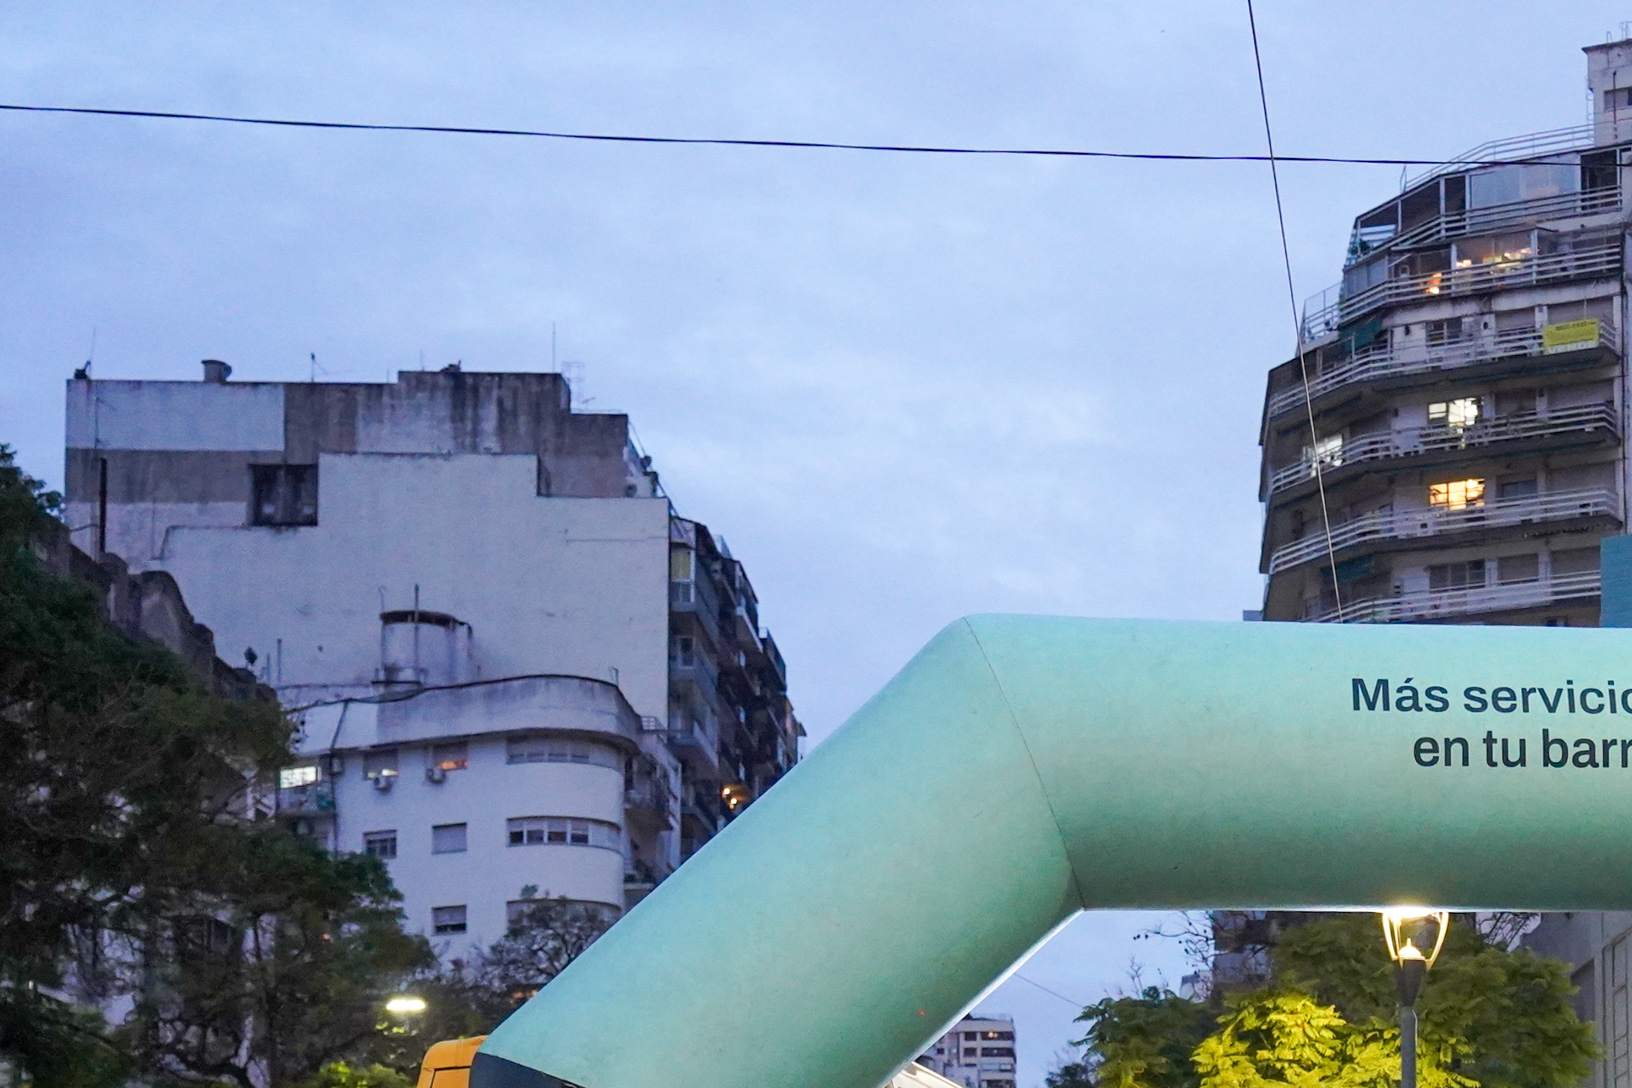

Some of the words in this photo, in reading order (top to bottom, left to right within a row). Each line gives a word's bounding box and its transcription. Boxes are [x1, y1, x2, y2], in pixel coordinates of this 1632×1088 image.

[1351, 677, 1450, 712] Más
[1413, 734, 1470, 767] en
[1482, 730, 1527, 768] tu
